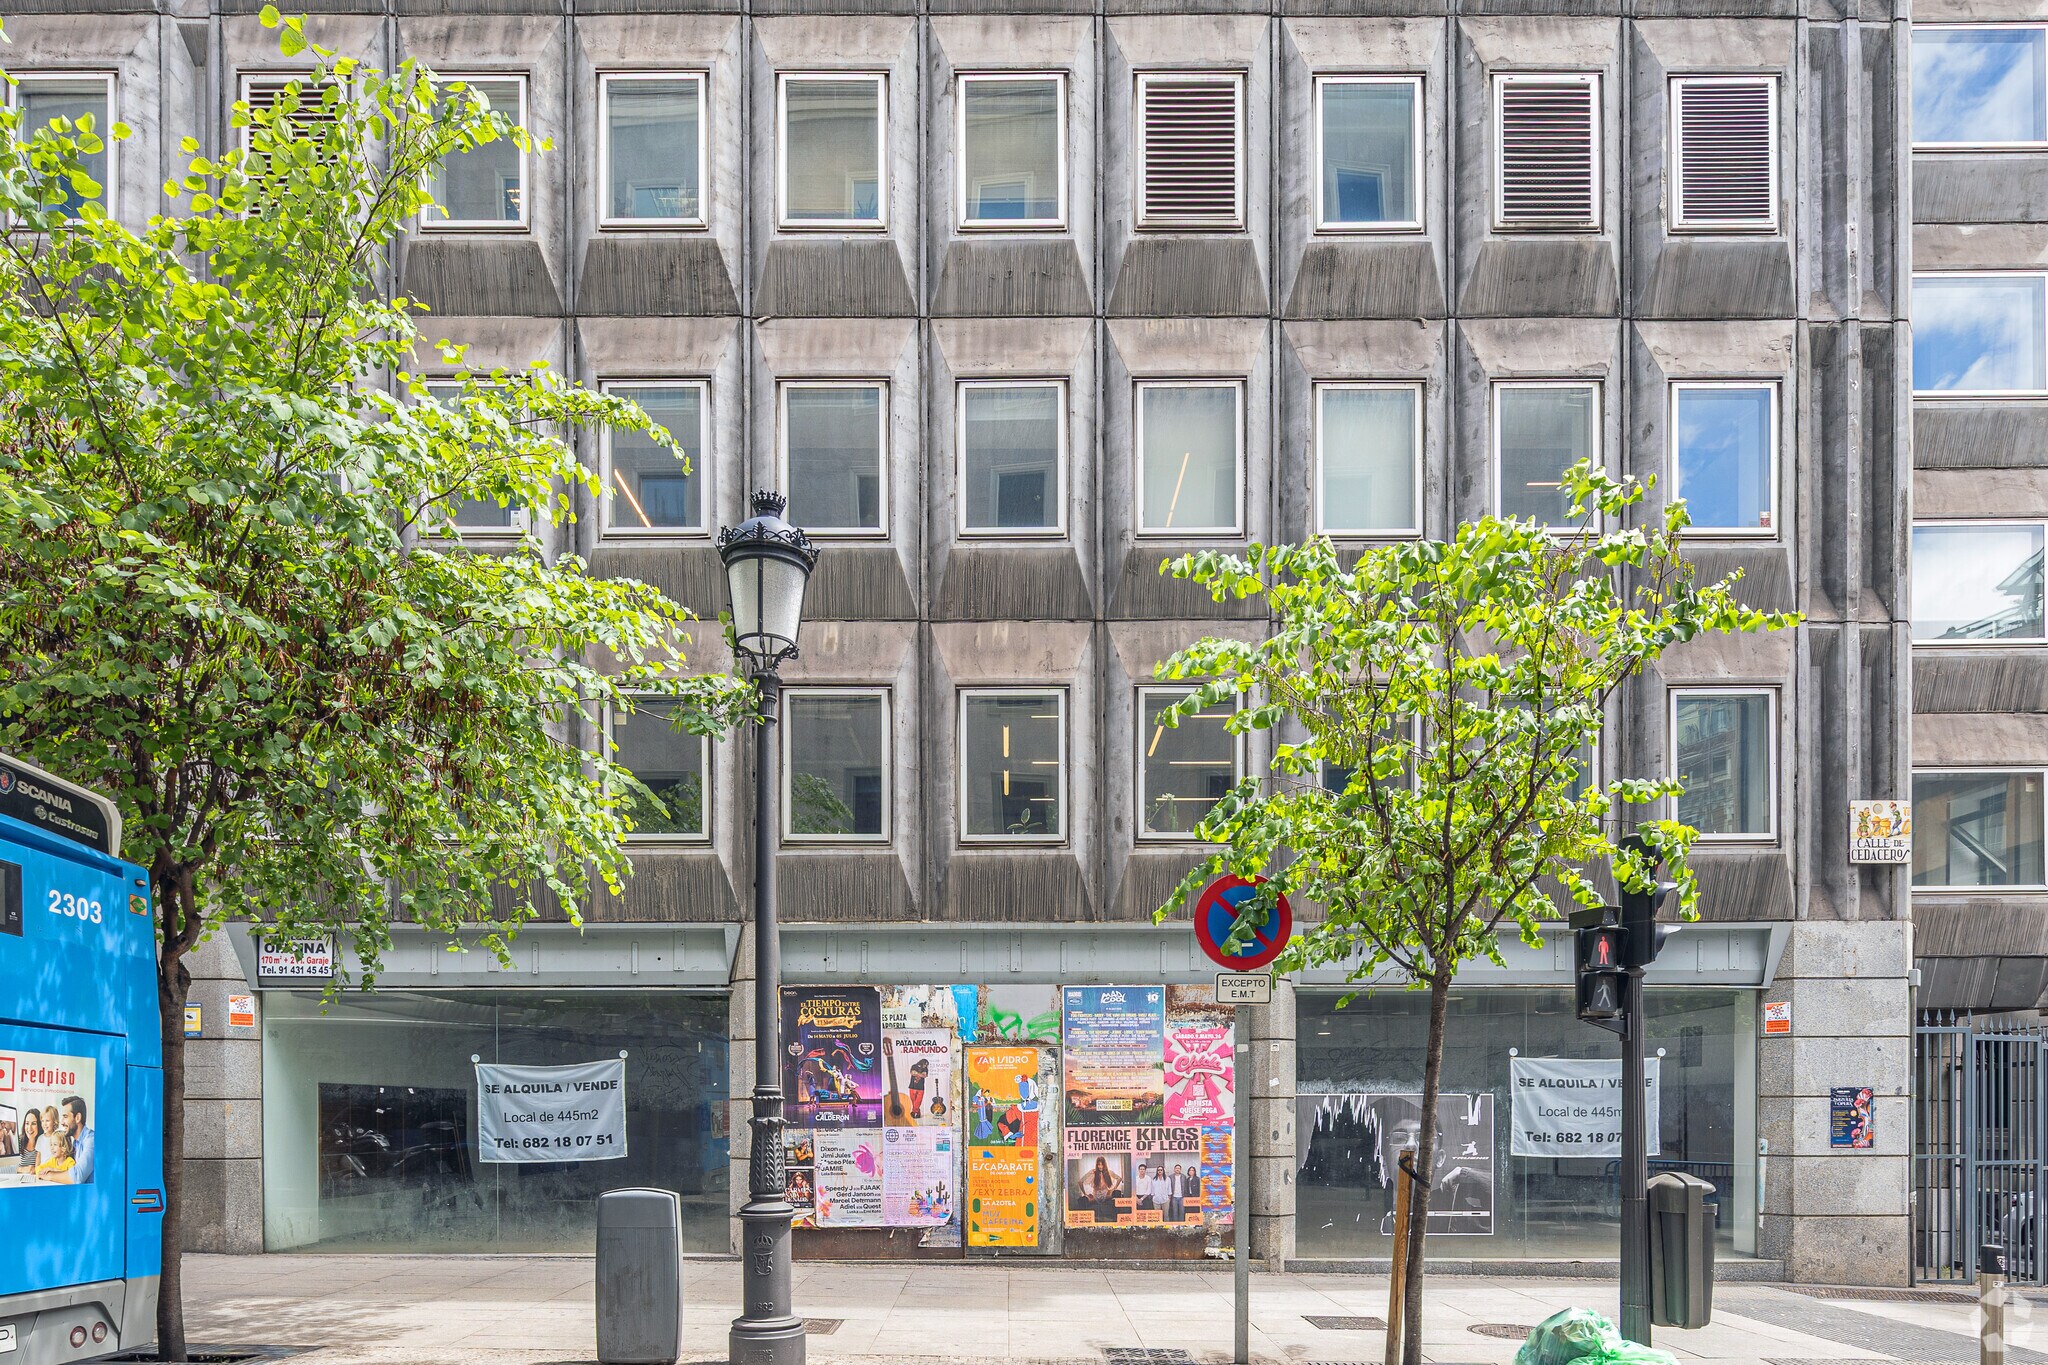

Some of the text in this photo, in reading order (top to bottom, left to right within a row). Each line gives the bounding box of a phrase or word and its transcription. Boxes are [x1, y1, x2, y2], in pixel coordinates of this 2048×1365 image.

[17, 781, 72, 813] SCANIA
[48, 812, 98, 839] Castrosua
[1857, 838, 1890, 848] CALLE
[1852, 849, 1910, 861] CEDACEROS
[49, 890, 102, 924] 2303
[306, 956, 329, 966] Garaje
[800, 1007, 860, 1015] COSTURAS
[978, 1056, 1028, 1064] SAN ISIDRO
[20, 1067, 75, 1086] redpiso
[485, 1080, 618, 1094] SE ALQUILA / VENDE
[1519, 1078, 1652, 1088] SE ALQUILA / VEE
[504, 1110, 599, 1123] Local de 445m2
[1538, 1106, 1570, 1117] Local
[1574, 1107, 1588, 1117] de
[1068, 1130, 1131, 1142] FLORENCE
[1137, 1128, 1198, 1140] KINGS
[1526, 1132, 1622, 1143] Tel: 682 18 07
[494, 1134, 613, 1148] Tel: 682 18 07 51
[1092, 1142, 1131, 1150] MACHINE
[1136, 1141, 1198, 1150] OF LEON
